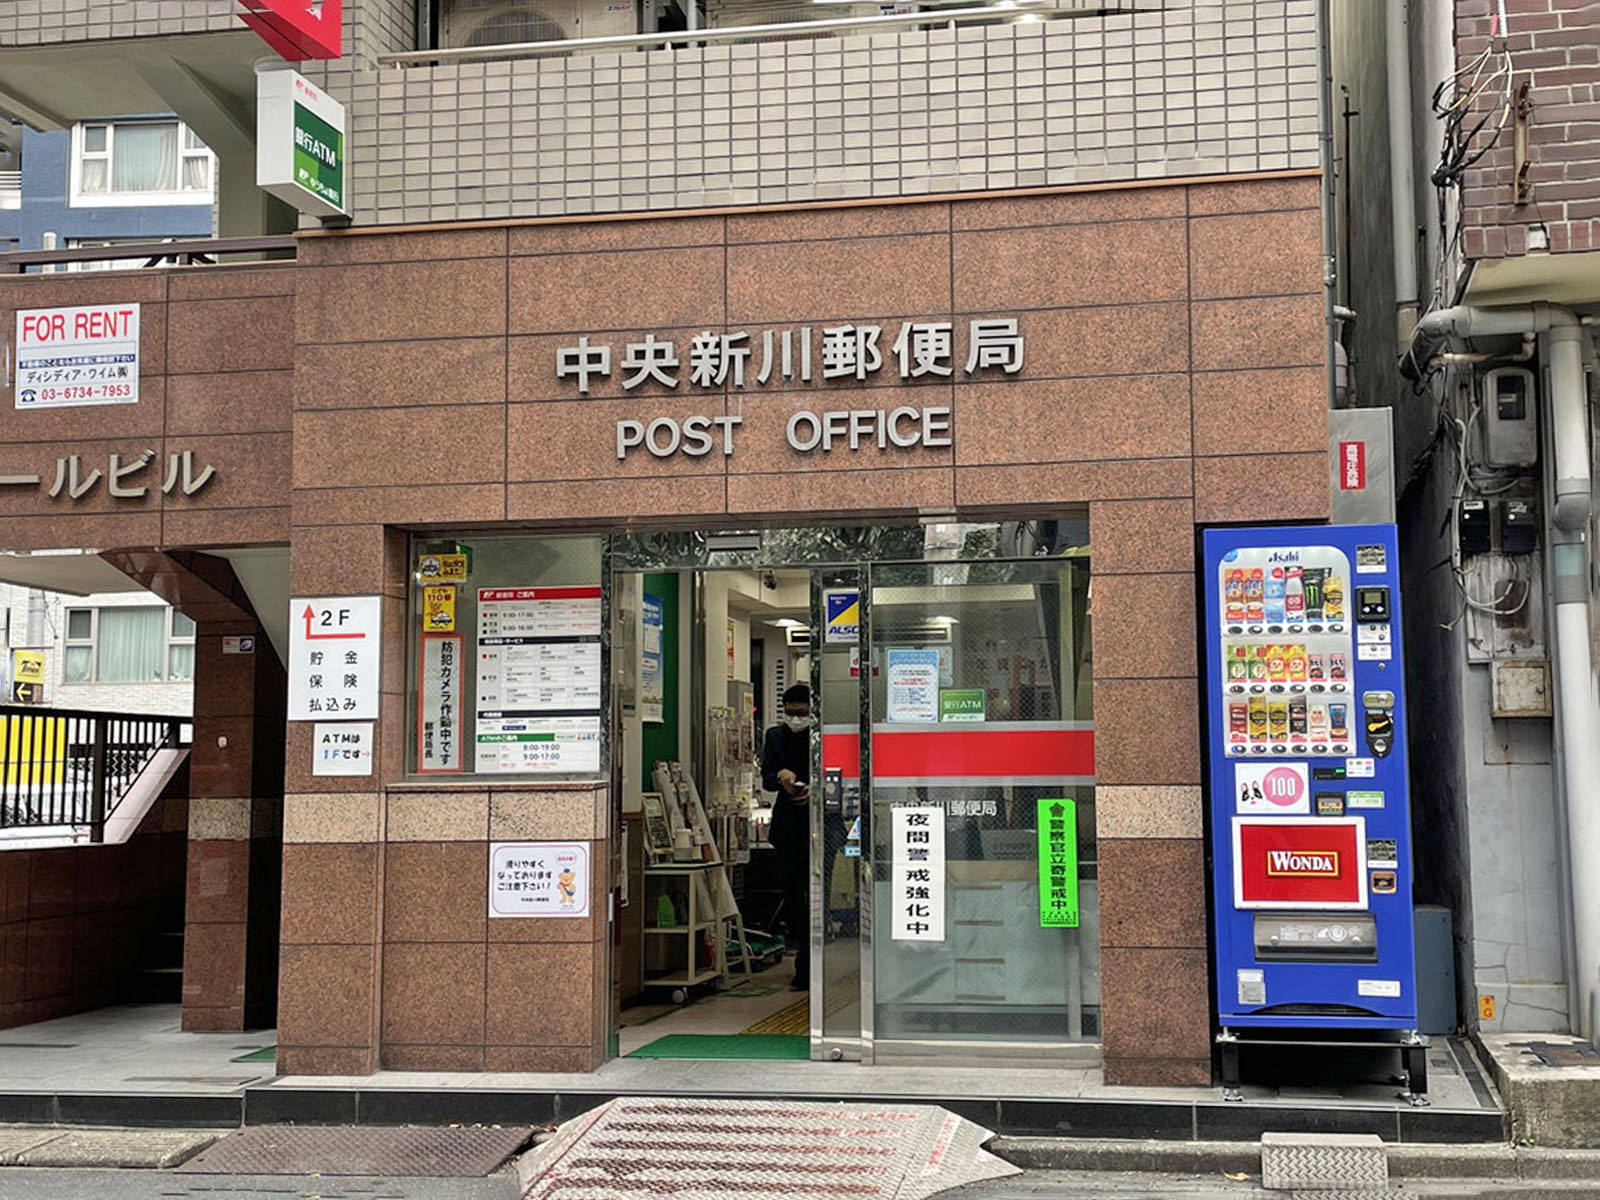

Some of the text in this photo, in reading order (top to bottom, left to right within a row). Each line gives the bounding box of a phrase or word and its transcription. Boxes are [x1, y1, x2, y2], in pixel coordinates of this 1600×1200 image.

[295, 126, 336, 168] 銀行ATM
[23, 310, 133, 342] FOR RENT
[555, 317, 1026, 395] 中央新川郵便局
[41, 384, 131, 401] 03-6734-7953
[616, 406, 953, 460] POST OFFICE
[0, 448, 216, 500] ールビル
[1268, 551, 1300, 563] Asahi
[321, 609, 350, 627] 2F
[310, 650, 358, 666] 貯金
[309, 674, 358, 688] 保険
[309, 697, 357, 713] 払込み
[440, 641, 453, 765] 防犯カメラ作動中です
[944, 700, 982, 709] 銀行ATM
[322, 733, 361, 744] ATMは
[323, 749, 361, 760] 1Fです
[1272, 776, 1296, 796] 100
[506, 860, 545, 869] 滑りやすく
[1049, 819, 1067, 910] 警察官立寄警戒中
[1271, 851, 1333, 871] WONDA
[497, 871, 552, 880] なっております
[905, 812, 930, 935] 夜間警戒強化中
[1483, 1007, 1493, 1018] G
